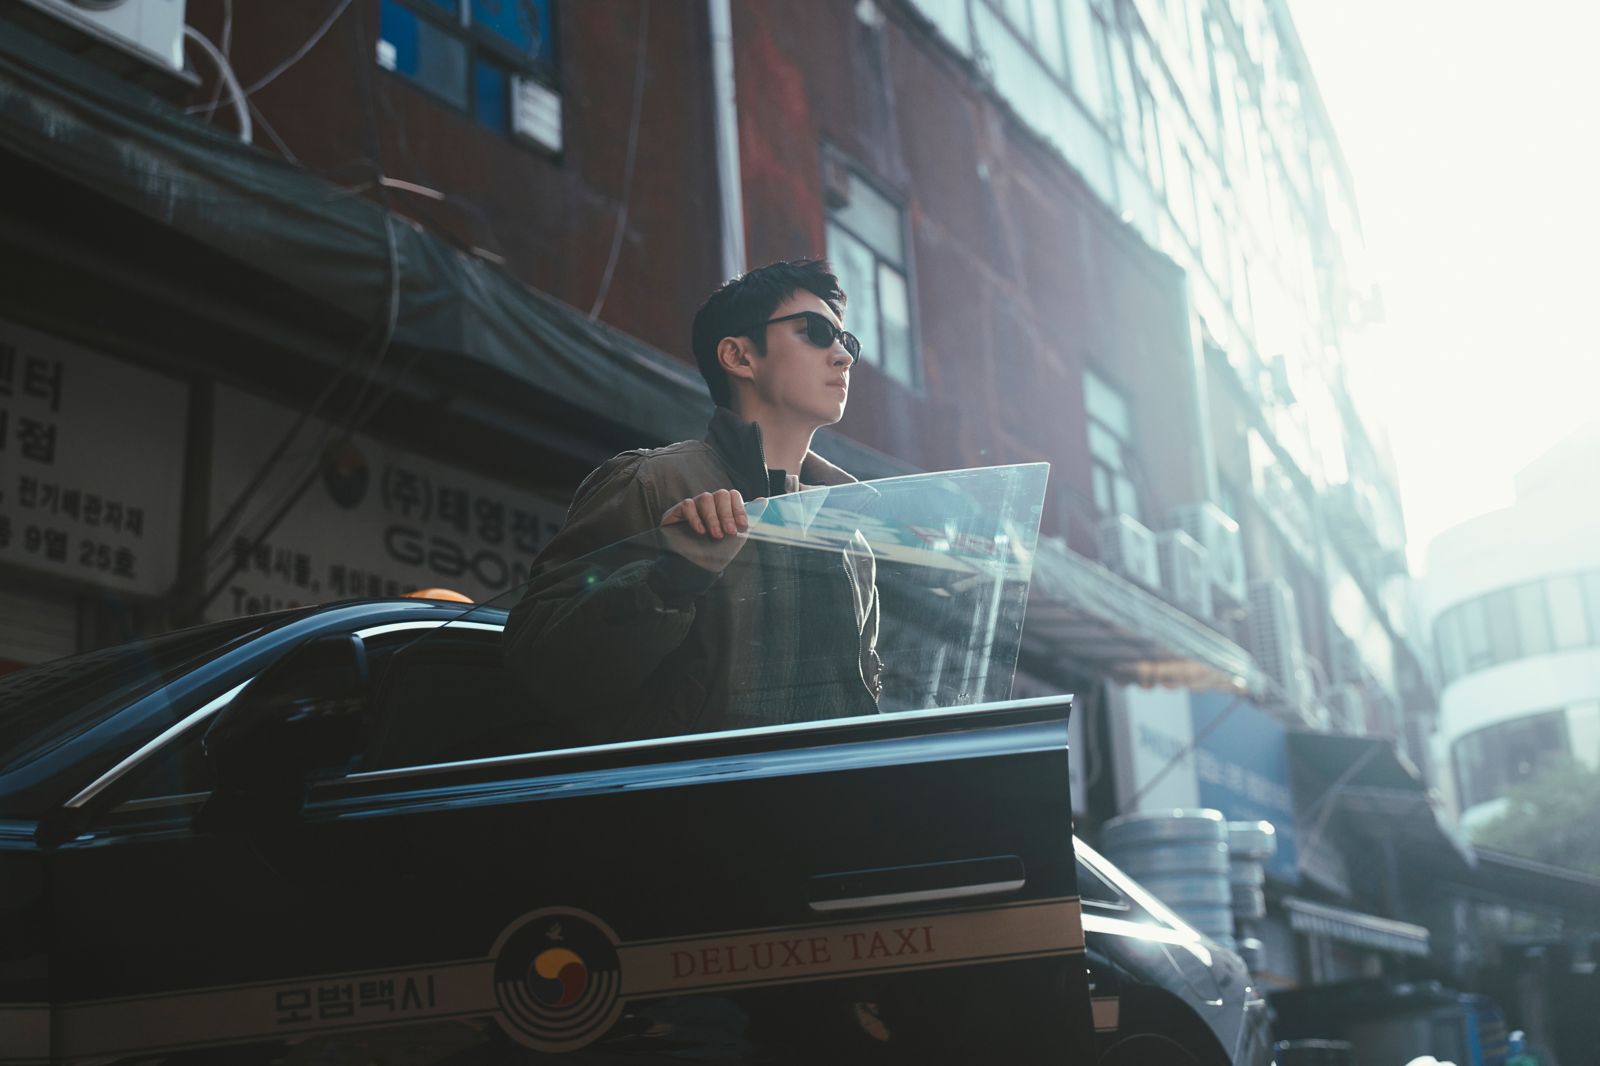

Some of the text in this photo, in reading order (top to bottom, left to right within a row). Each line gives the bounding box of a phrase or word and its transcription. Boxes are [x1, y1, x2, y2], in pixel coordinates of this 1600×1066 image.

[0, 408, 57, 466] 점
[381, 463, 559, 555] (주)태영전
[670, 926, 937, 978] DELUXE TAXI
[276, 974, 435, 1025] 모범택시
